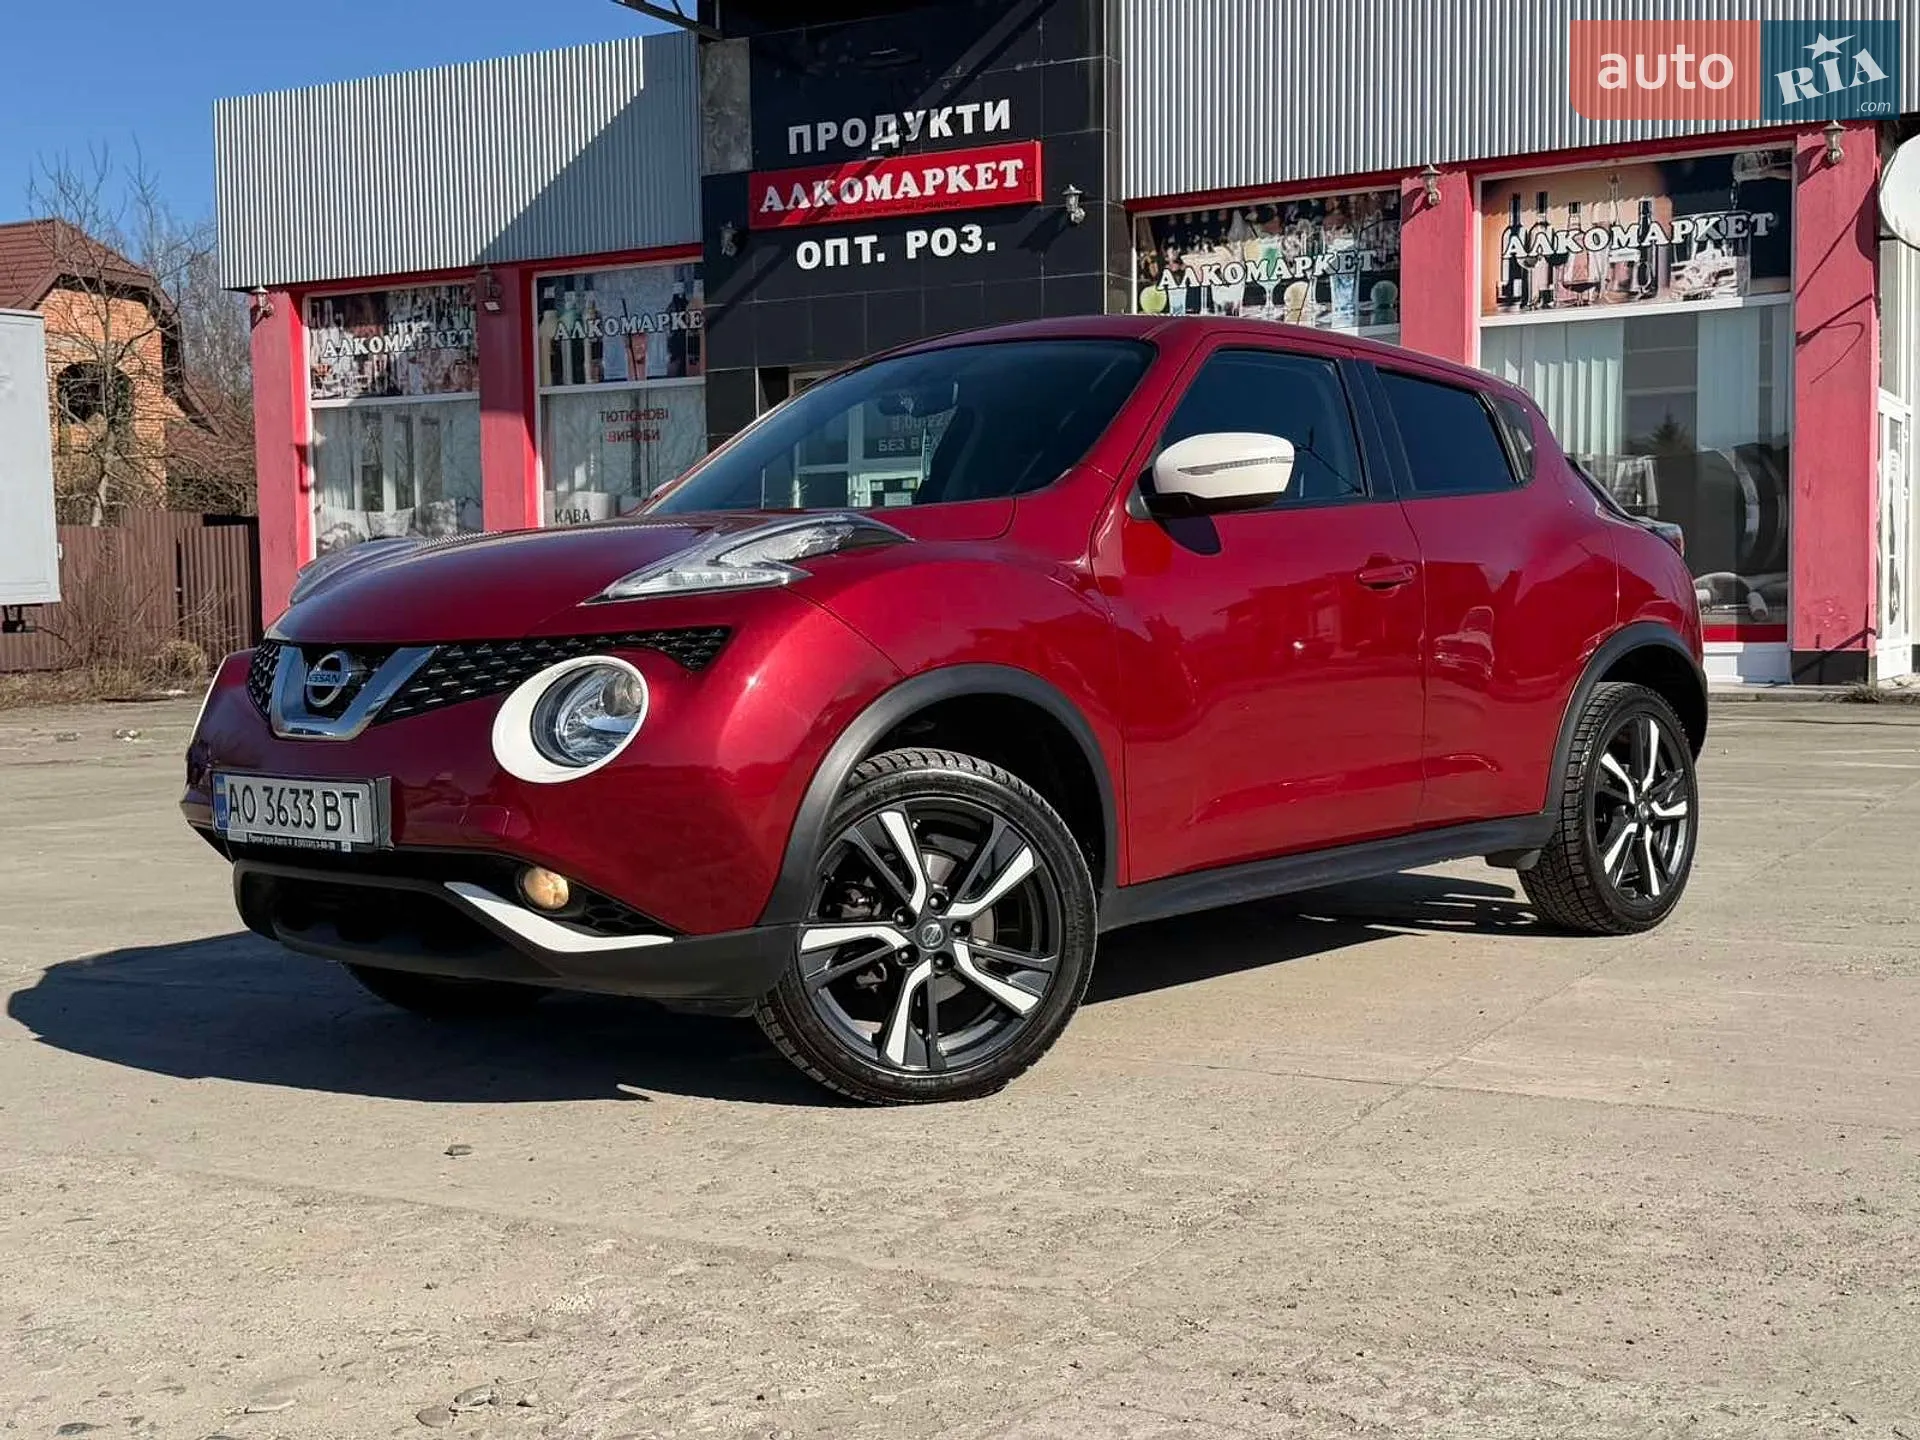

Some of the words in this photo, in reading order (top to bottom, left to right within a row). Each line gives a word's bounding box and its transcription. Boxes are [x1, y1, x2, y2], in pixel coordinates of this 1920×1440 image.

[787, 98, 1011, 155] ПРОДУКТИ
[759, 158, 1024, 213] АЛКОМАРКЕТ
[796, 235, 886, 271] ОПТ.
[906, 224, 997, 260] РОЗ.
[1502, 211, 1776, 259] АЛКОМАРКЕТ
[1156, 250, 1377, 291] АЛКОМАРКЕТ
[321, 328, 473, 358] АЛКОМАРКЕТ
[607, 428, 661, 443] ВИРОБИ
[554, 508, 591, 525] КАВА
[263, 785, 317, 830] 3633
